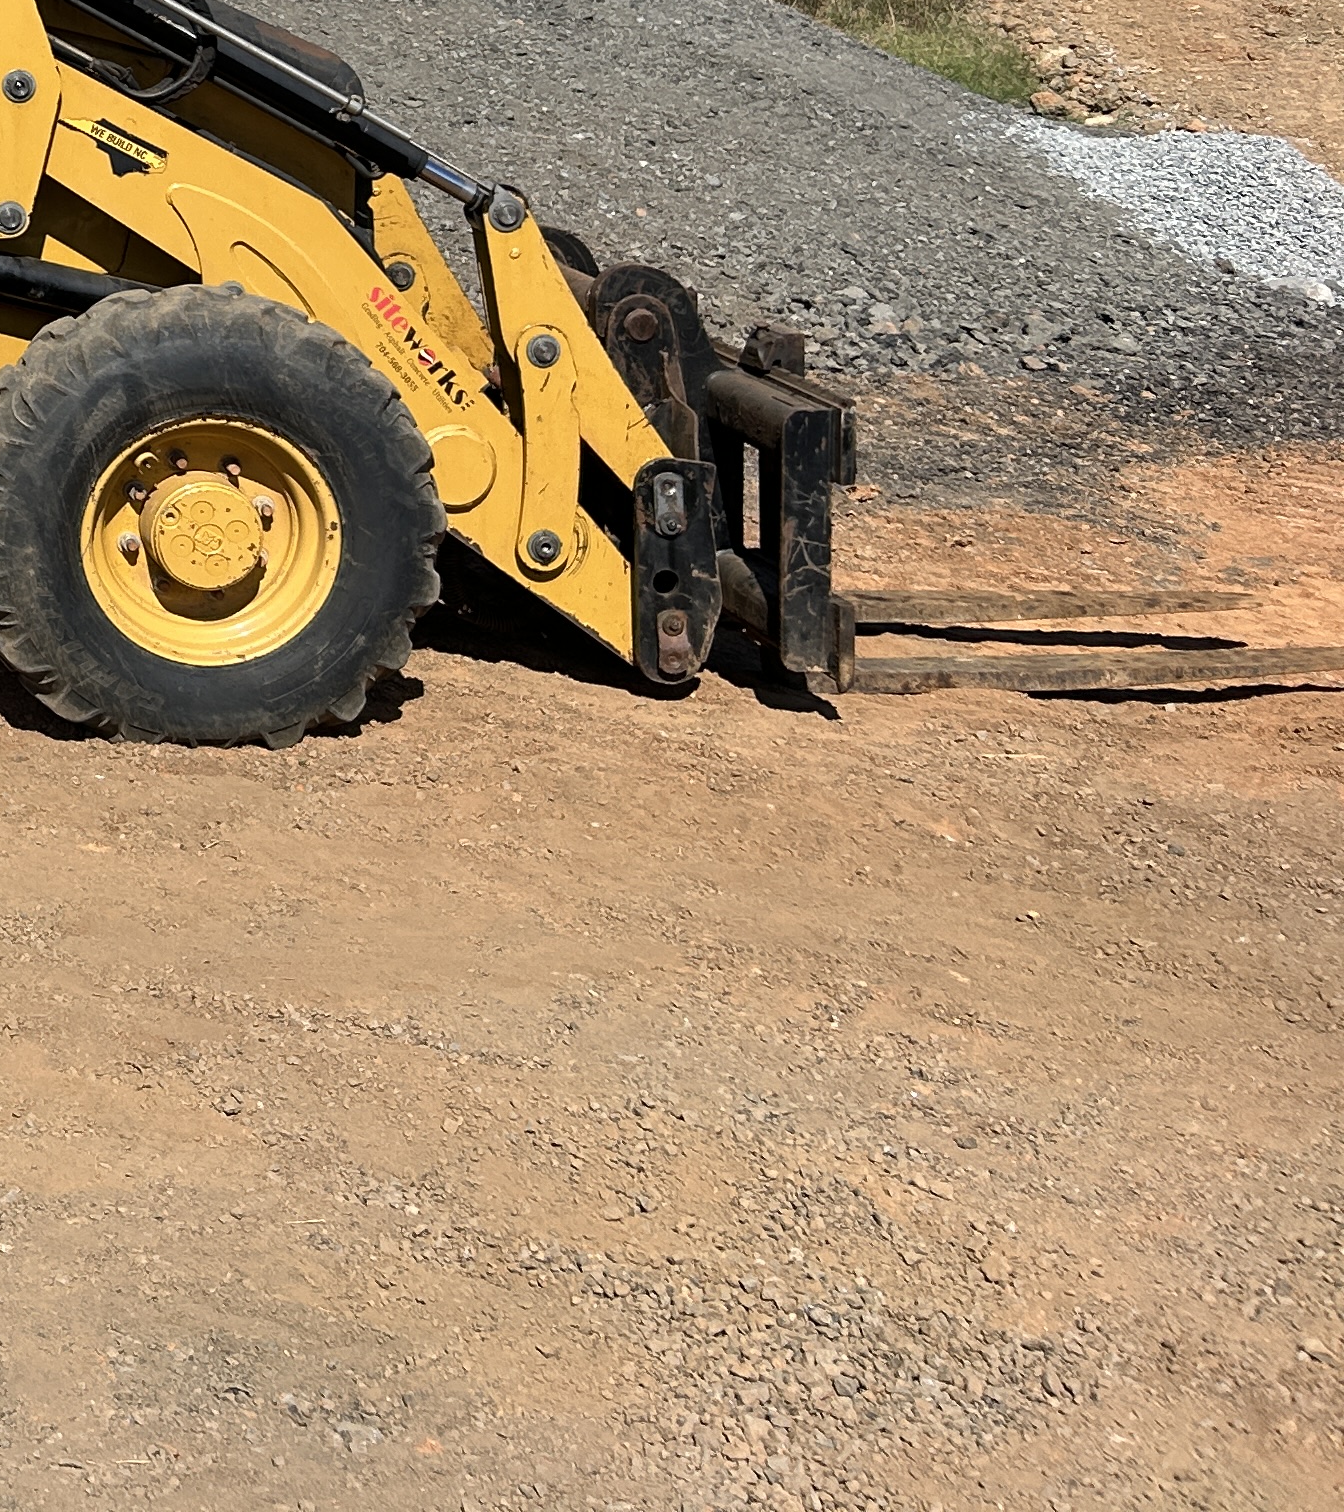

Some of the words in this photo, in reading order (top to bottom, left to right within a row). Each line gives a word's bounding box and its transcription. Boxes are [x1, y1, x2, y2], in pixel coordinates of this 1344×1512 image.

[91, 124, 107, 138] WE
[106, 133, 133, 152] BUILD
[133, 146, 148, 160] NC
